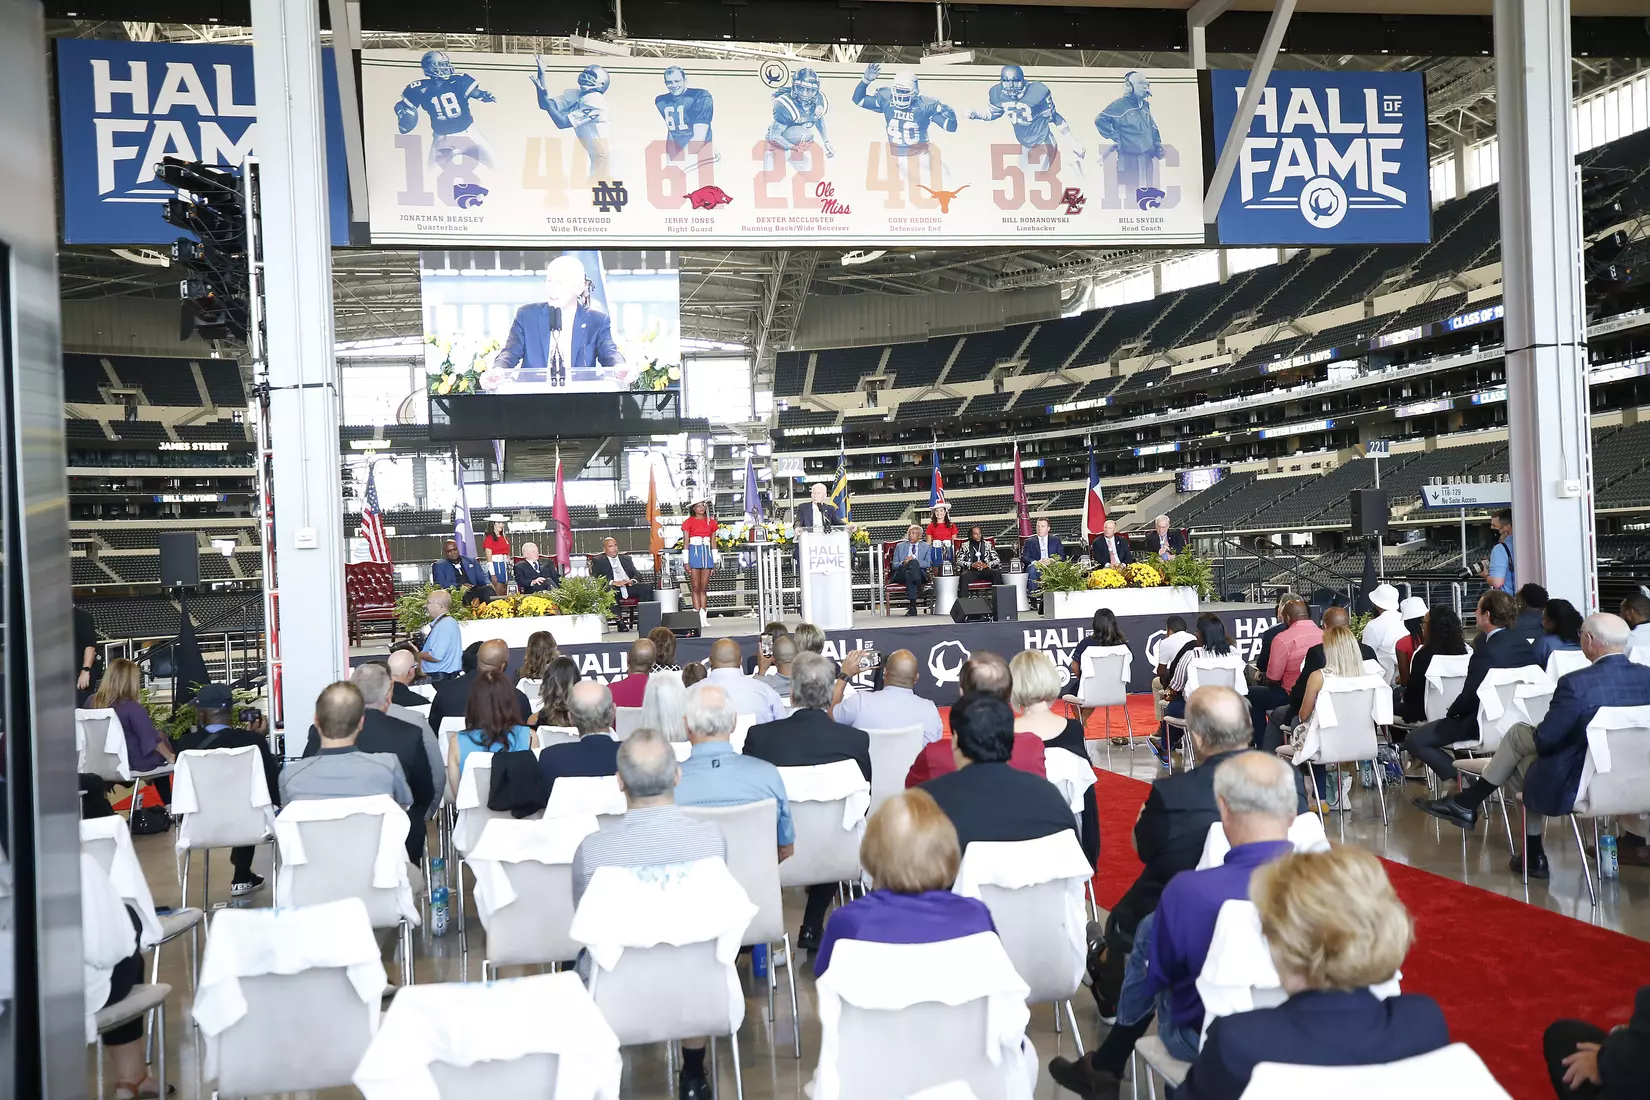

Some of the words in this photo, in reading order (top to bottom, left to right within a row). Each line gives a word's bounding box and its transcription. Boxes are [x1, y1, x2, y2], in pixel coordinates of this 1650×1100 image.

[90, 59, 257, 117] HAL
[430, 91, 463, 121] 18
[893, 109, 915, 121] TEXAS
[1001, 101, 1033, 125] 53
[1235, 87, 1403, 133] HALL
[663, 105, 690, 132] 61
[887, 118, 921, 146] 40
[93, 118, 258, 196] FAM
[394, 134, 481, 207] 18
[645, 140, 724, 210] 61
[751, 139, 825, 209] 22
[866, 142, 943, 209] 40
[990, 143, 1063, 211] 53
[1239, 137, 1407, 204] FAME
[815, 181, 835, 198] Ole
[821, 198, 851, 214] Miss
[400, 214, 444, 222] JONATHAN
[447, 215, 484, 223] BEASLEY
[416, 223, 468, 232] Quarterback
[774, 224, 815, 232] Back/Wide
[667, 225, 688, 233] Right
[1453, 313, 1480, 329] CLASS
[1480, 310, 1494, 323] OF
[1494, 306, 1505, 319] 19
[158, 441, 191, 451] JAMES
[191, 442, 229, 451] STREET
[1370, 441, 1385, 453] 221
[782, 459, 800, 471] 222
[1447, 475, 1474, 485] HALL
[1479, 474, 1492, 484] OF
[1497, 473, 1510, 483] FA
[1441, 488, 1461, 497] 118-129
[1461, 496, 1477, 504] Access
[808, 545, 844, 556] HALL
[809, 555, 846, 570] FAME
[1235, 637, 1263, 662] FA
